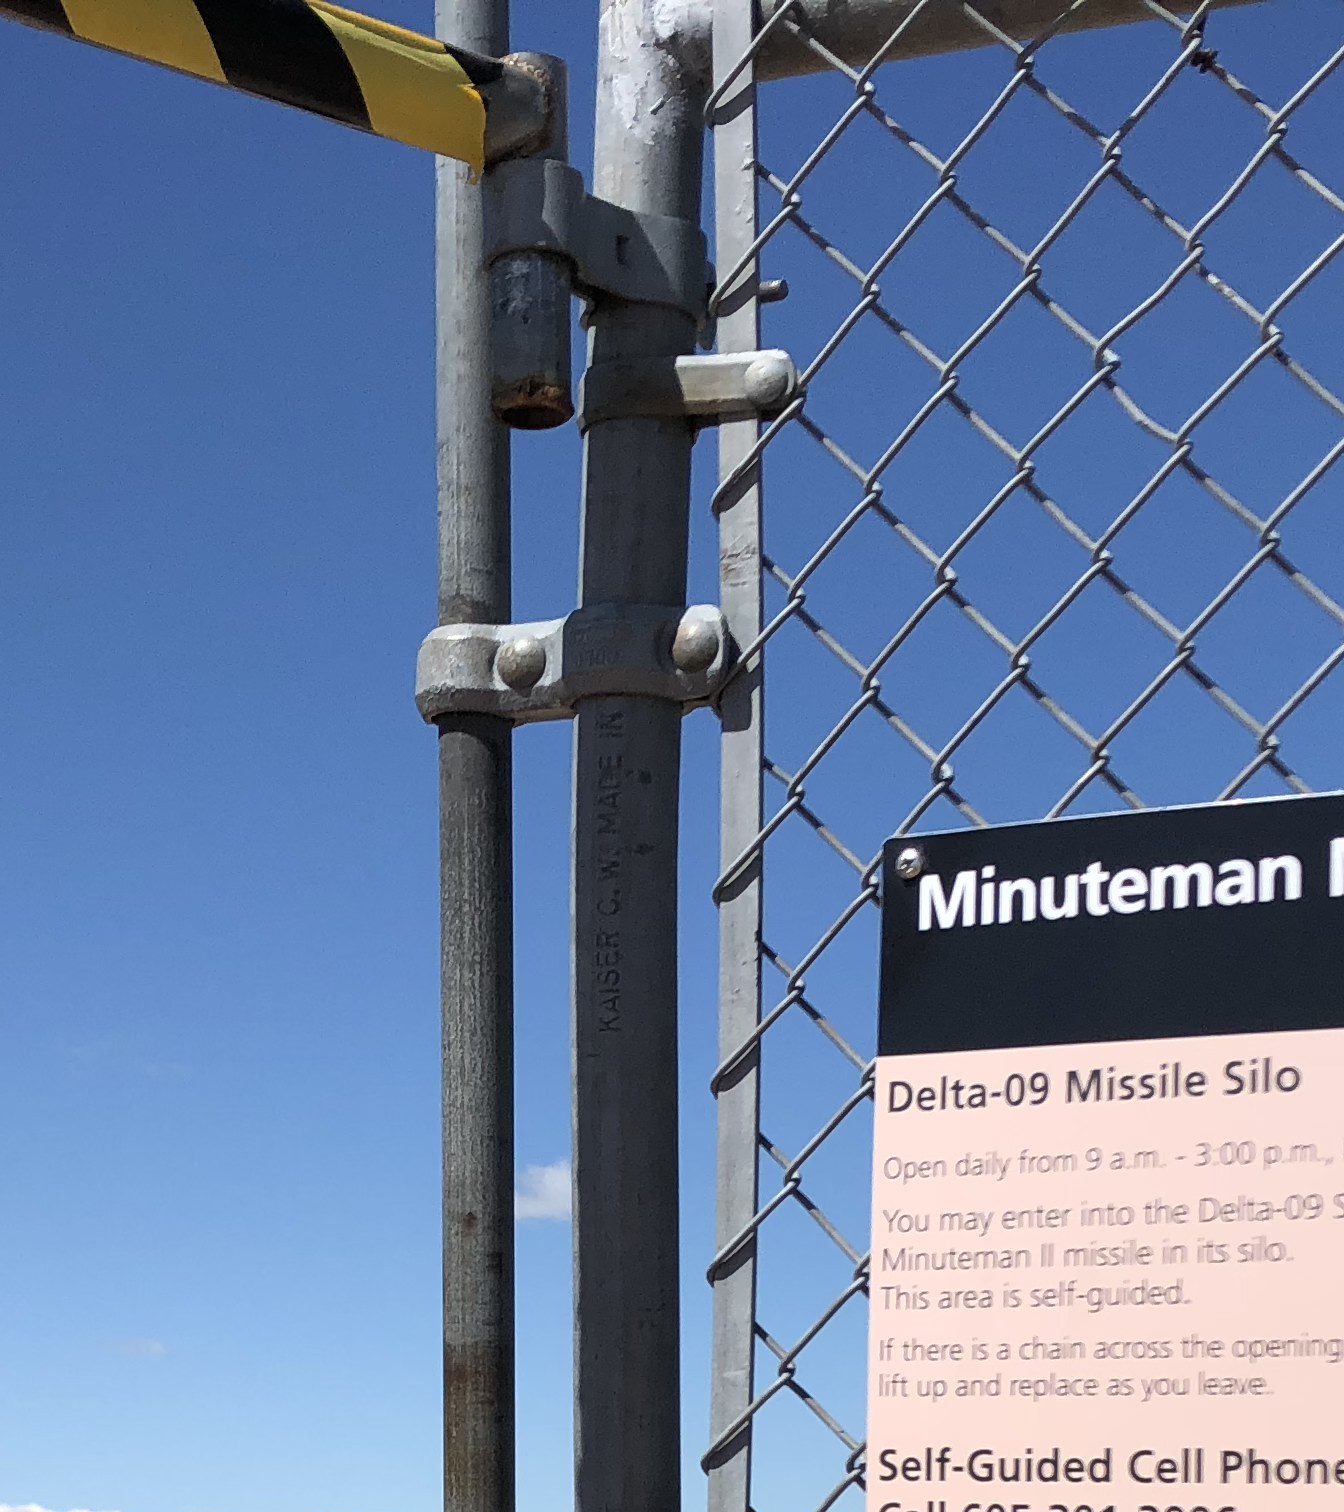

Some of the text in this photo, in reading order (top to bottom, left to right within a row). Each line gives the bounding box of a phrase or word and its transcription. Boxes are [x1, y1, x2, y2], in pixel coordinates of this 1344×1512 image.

[917, 854, 1304, 933] Minuteman
[887, 1056, 1301, 1114] Delta-09 Missile Silo
[883, 1155, 947, 1186] Open
[954, 1150, 1012, 1182] daily
[1017, 1147, 1078, 1175] from
[1084, 1145, 1103, 1173] 9
[1193, 1139, 1257, 1168] 3:00
[882, 1207, 930, 1234] You
[939, 1210, 995, 1238] may
[1001, 1204, 1073, 1231] enter
[1080, 1201, 1135, 1228] into
[1142, 1197, 1190, 1226] the
[1198, 1192, 1324, 1224] Delta-09
[881, 1246, 1031, 1273] Minuteman
[1063, 1239, 1154, 1268] missile
[1162, 1239, 1187, 1265] in
[1197, 1237, 1231, 1265] its
[880, 1278, 1191, 1314] This area is self-guided.
[879, 1336, 896, 1362] If
[901, 1337, 964, 1363] there
[971, 1336, 990, 1362] is
[995, 1341, 1011, 1361] a
[1018, 1335, 1086, 1361] chain
[1093, 1339, 1174, 1361] across
[1179, 1333, 1226, 1360] the
[1231, 1332, 1344, 1365] opening
[878, 1372, 909, 1399] lift
[916, 1379, 948, 1404] up
[954, 1372, 1002, 1398] and
[1009, 1372, 1100, 1403] replace
[1106, 1377, 1135, 1398] as
[1140, 1377, 1190, 1403] you
[878, 1445, 1112, 1484] Self-Guided
[1128, 1447, 1204, 1485] Cell
